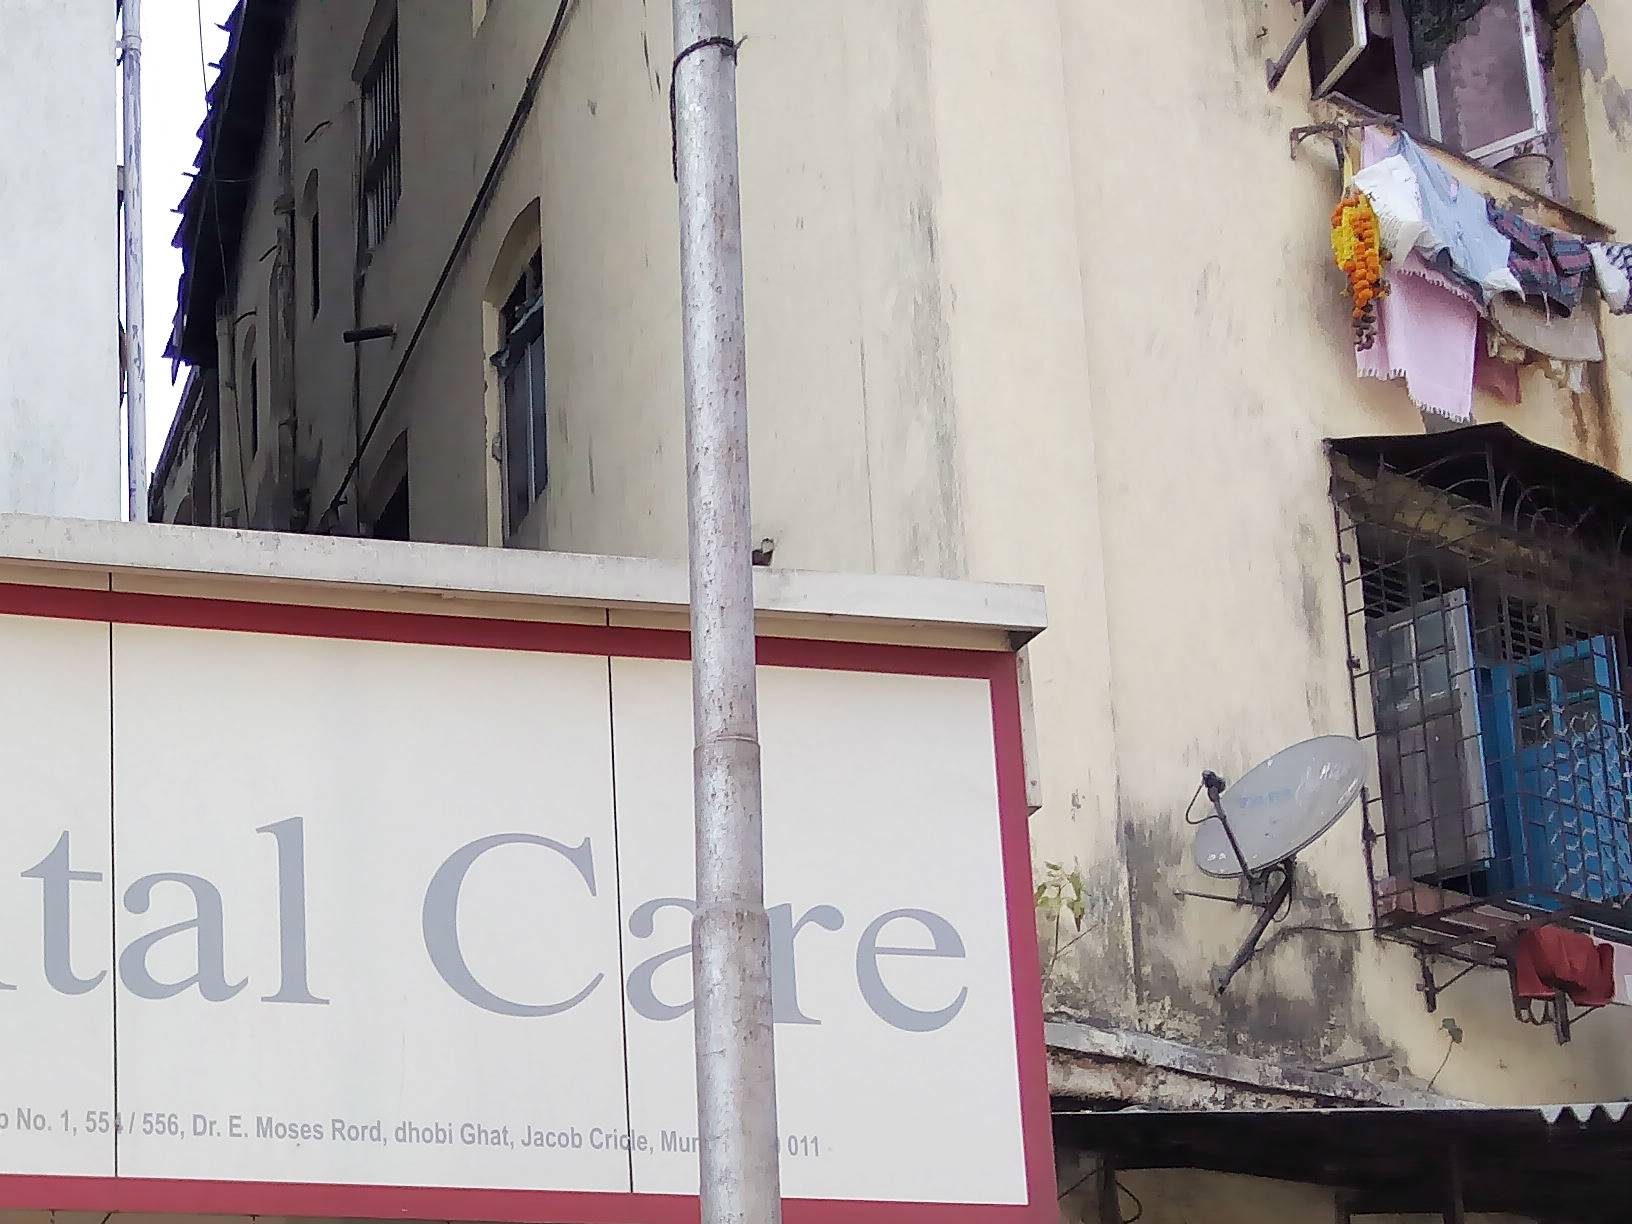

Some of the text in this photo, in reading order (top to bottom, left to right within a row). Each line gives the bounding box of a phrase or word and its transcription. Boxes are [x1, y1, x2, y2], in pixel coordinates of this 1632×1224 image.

[17, 1107, 52, 1131] No.
[60, 1109, 77, 1136] 1,
[142, 1112, 185, 1140] 556,
[192, 1113, 220, 1137] Dr.
[229, 1115, 248, 1138] E.
[256, 1116, 324, 1141] Moses
[331, 1118, 387, 1146] Rord,
[394, 1119, 453, 1145] dhobi
[460, 1122, 514, 1150] Ghat,
[521, 1124, 583, 1149] Jacob
[787, 1134, 820, 1158] 011
